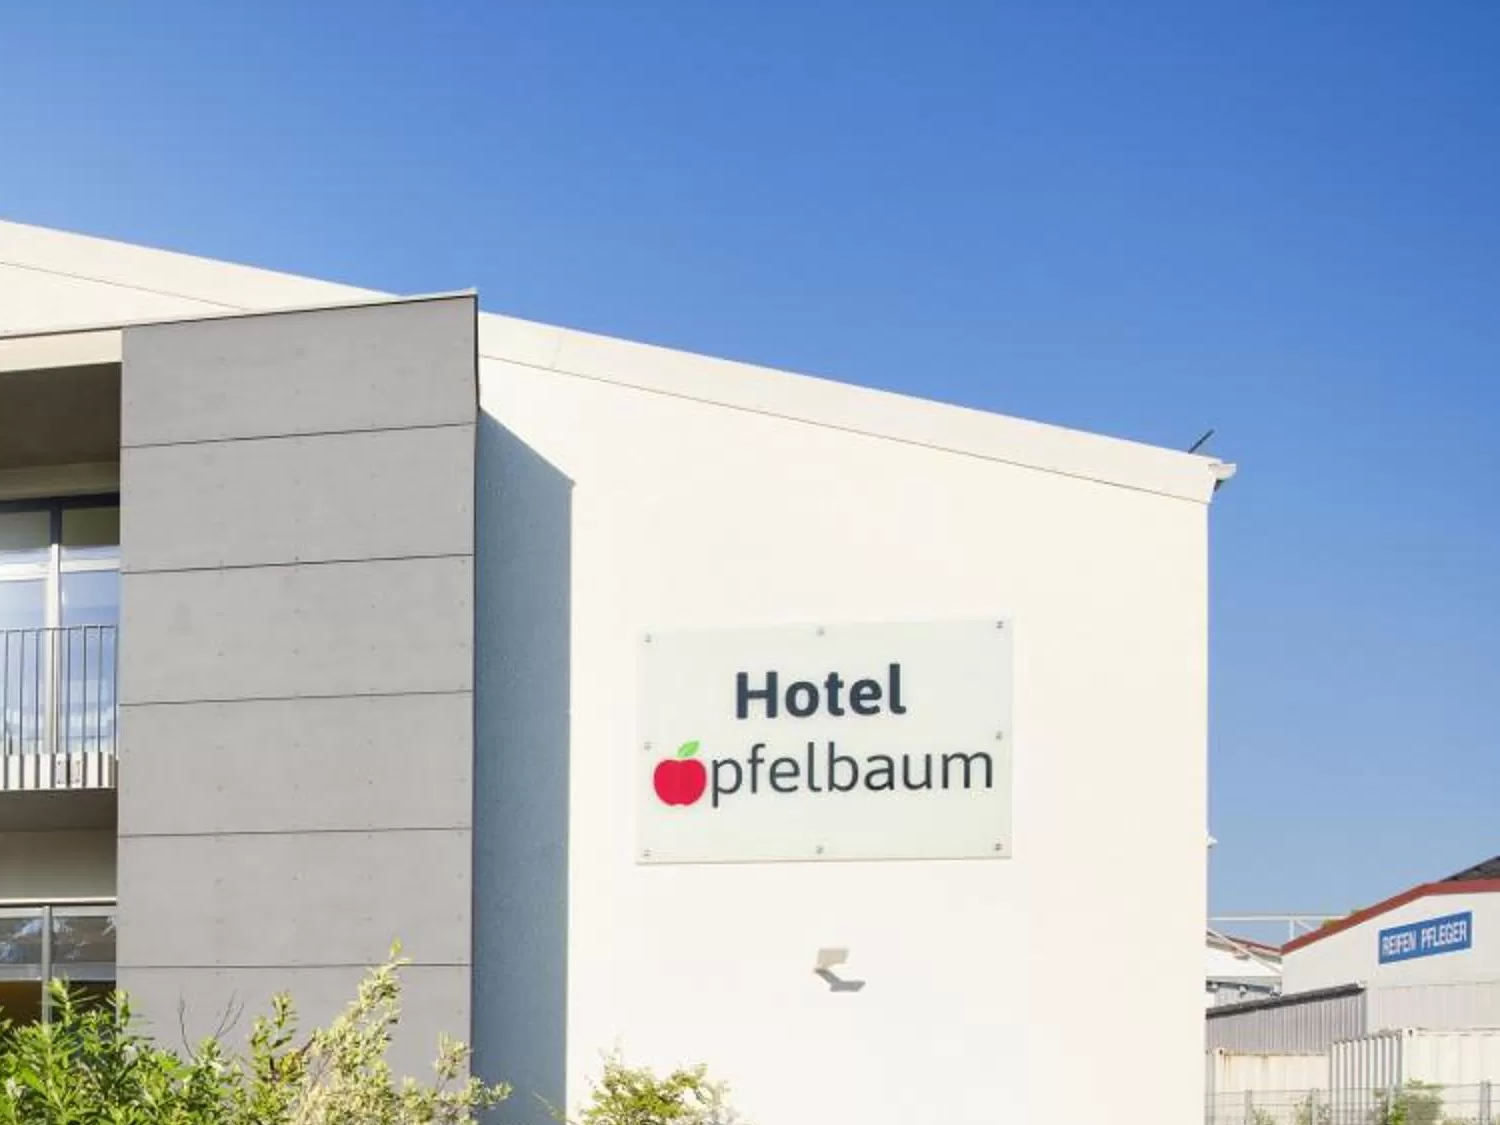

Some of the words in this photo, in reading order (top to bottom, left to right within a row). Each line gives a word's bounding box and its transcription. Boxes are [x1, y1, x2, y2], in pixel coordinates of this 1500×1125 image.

[735, 662, 907, 720] Hotel
[710, 740, 993, 809] pfelbaum
[1381, 930, 1417, 956] REIFEN
[1421, 920, 1467, 952] PFLEGER
